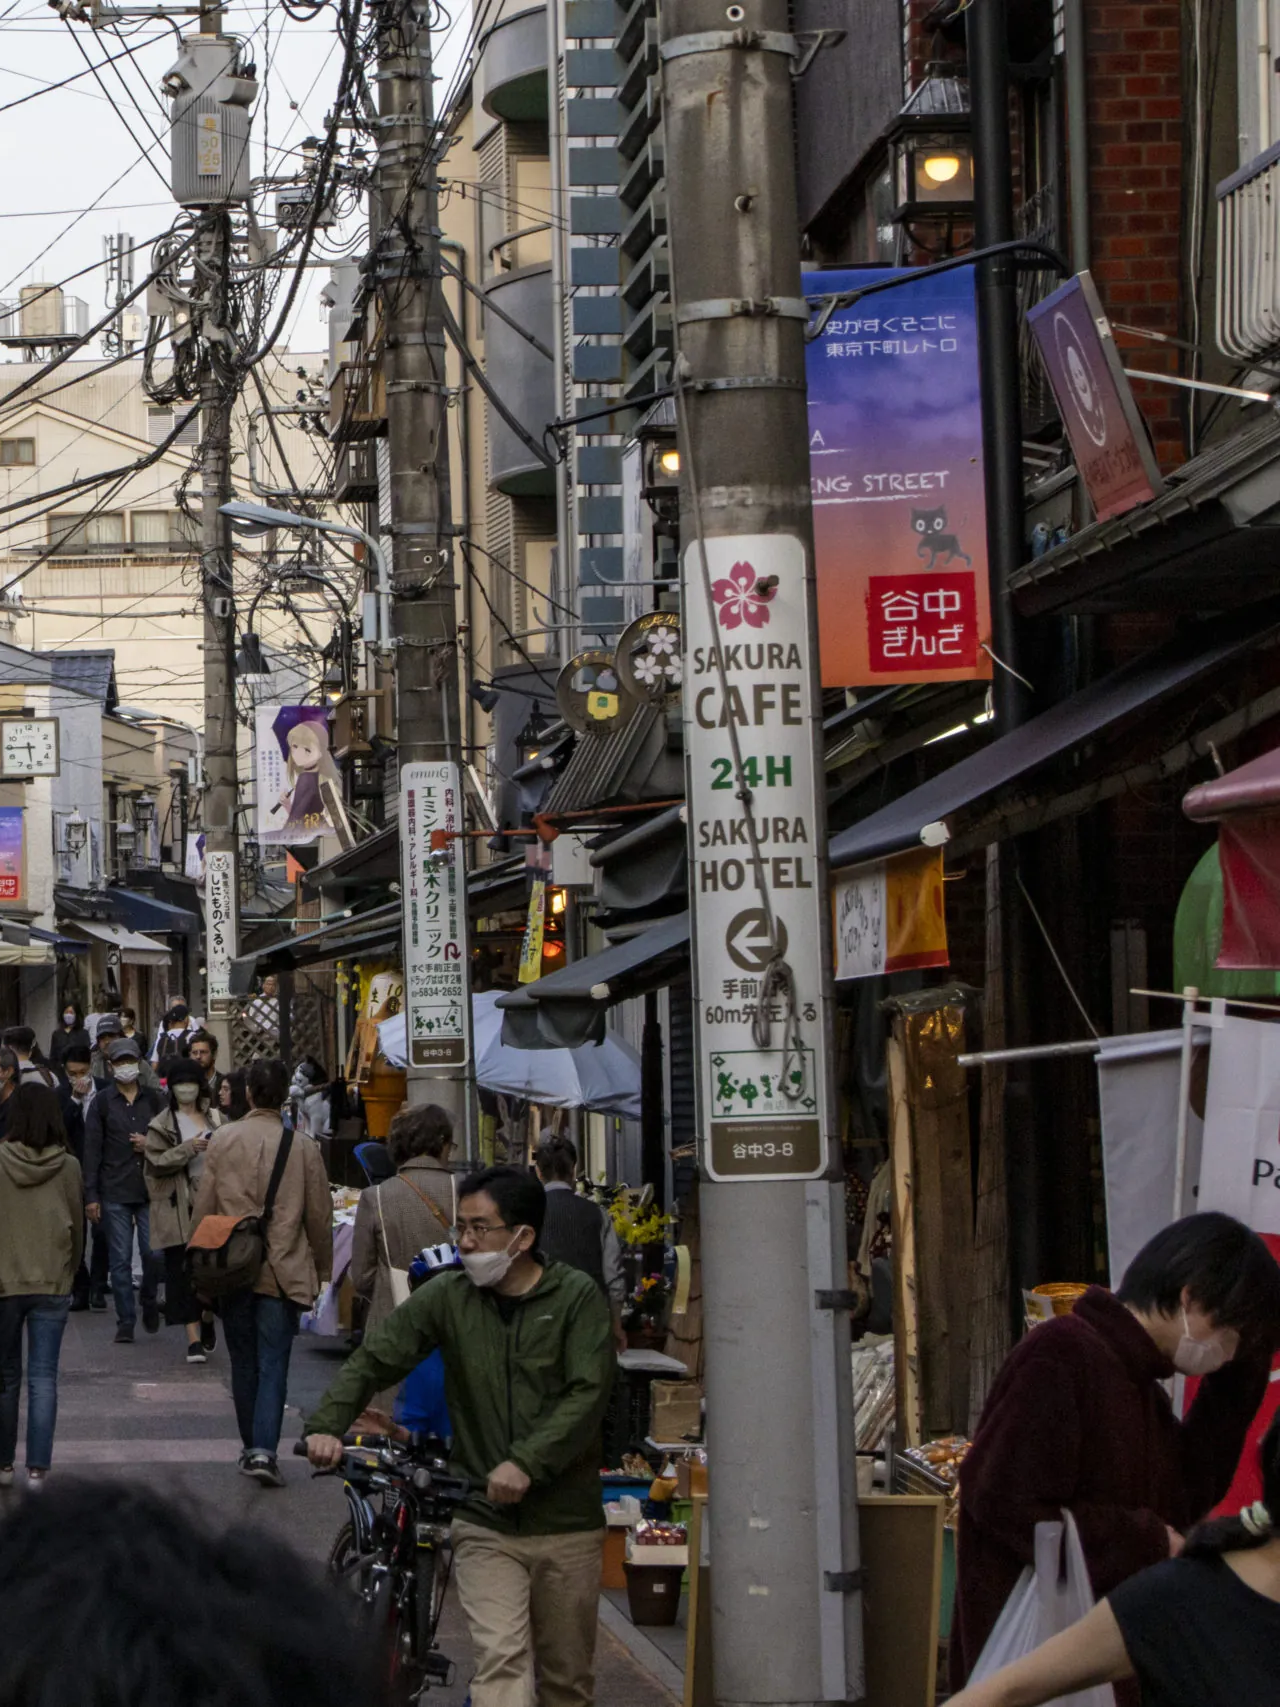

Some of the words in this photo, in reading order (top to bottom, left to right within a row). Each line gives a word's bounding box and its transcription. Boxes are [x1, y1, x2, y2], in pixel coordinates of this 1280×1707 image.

[825, 338, 957, 358] 東京下町レトロ
[862, 470, 951, 492] STREET
[880, 588, 961, 622] 谷中
[882, 624, 964, 658] ぎんざ
[693, 642, 803, 675] SAKURA
[695, 683, 803, 730] CAFE
[710, 755, 792, 790] 24H
[698, 816, 808, 848] SAKURA
[700, 856, 813, 893] HOTEL
[211, 873, 226, 955] しにものぐるい
[732, 1142, 794, 1160] 谷中3-8
